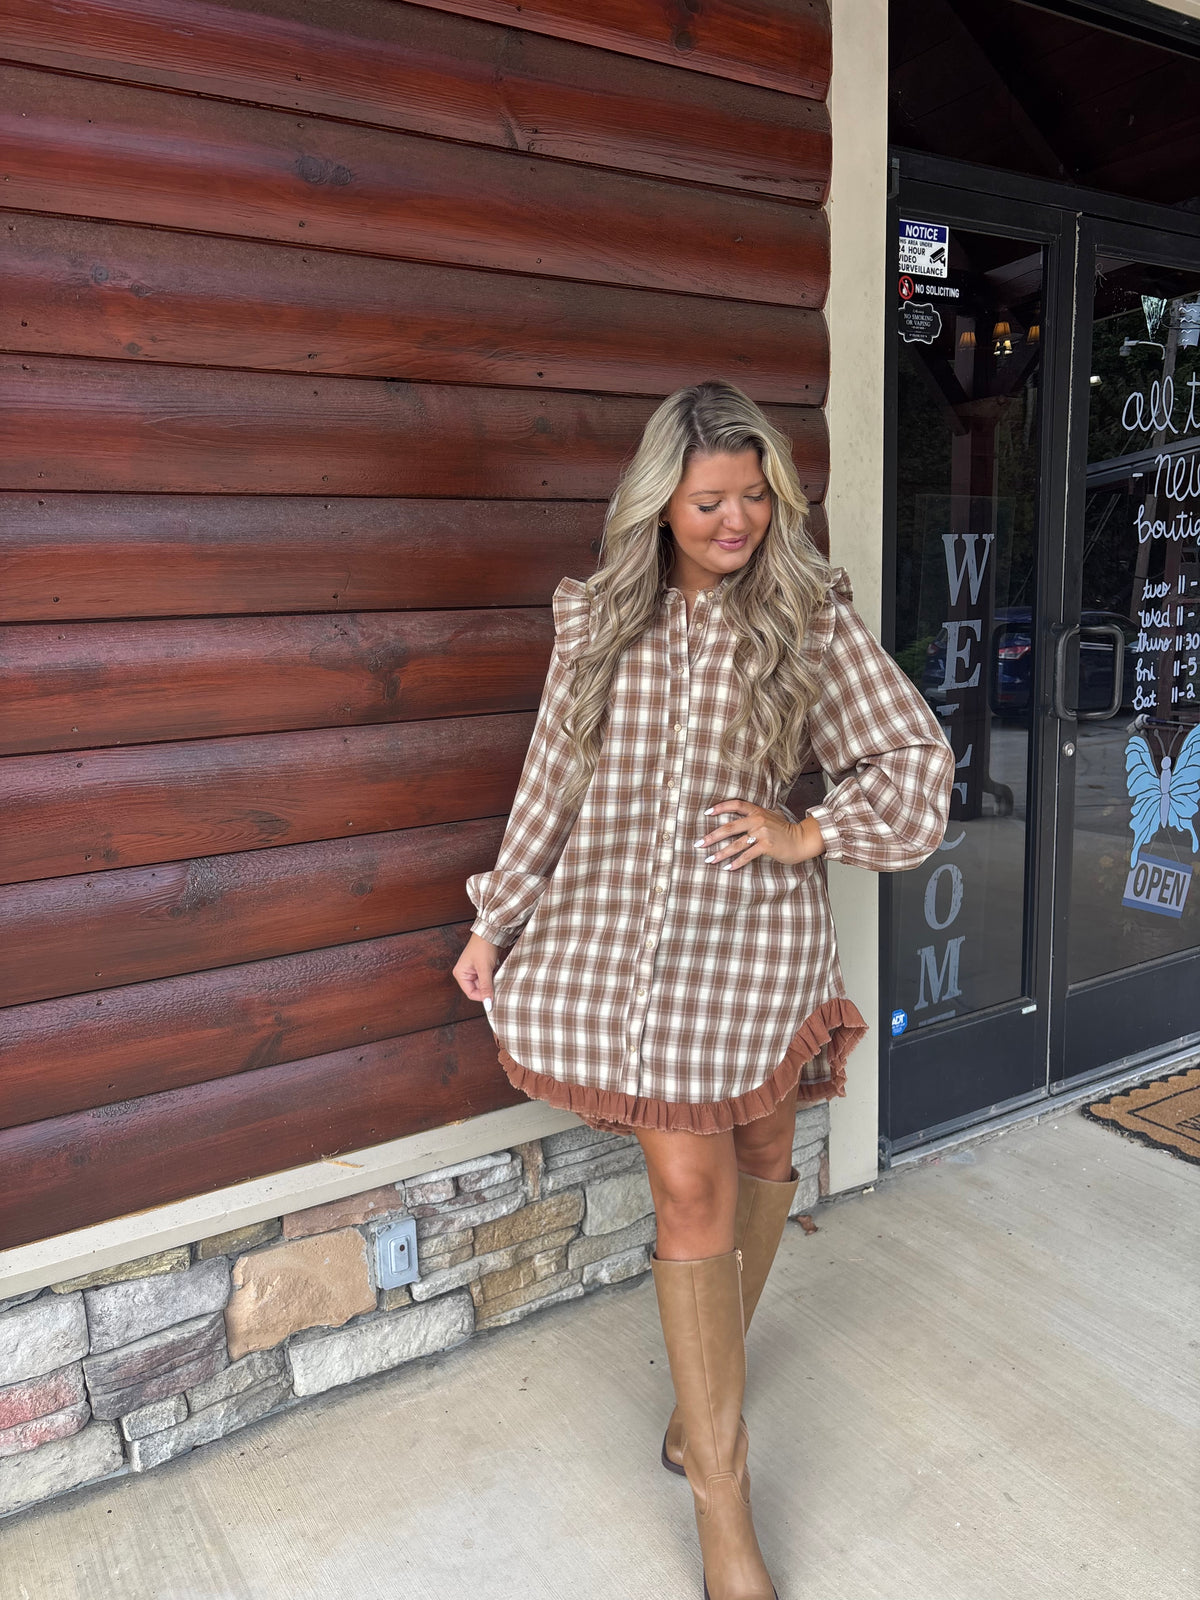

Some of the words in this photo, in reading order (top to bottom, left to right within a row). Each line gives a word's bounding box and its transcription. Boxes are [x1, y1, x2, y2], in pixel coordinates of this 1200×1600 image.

[905, 224, 939, 241] NOTICE
[908, 246, 926, 256] HOUR
[915, 283, 925, 294] NO
[926, 285, 960, 298] SOLICITING
[914, 320, 931, 328] VAPING
[1121, 375, 1179, 434] all
[914, 533, 995, 1027] WELOM
[1133, 863, 1187, 907] OPEN
[892, 1013, 905, 1026] ADT
